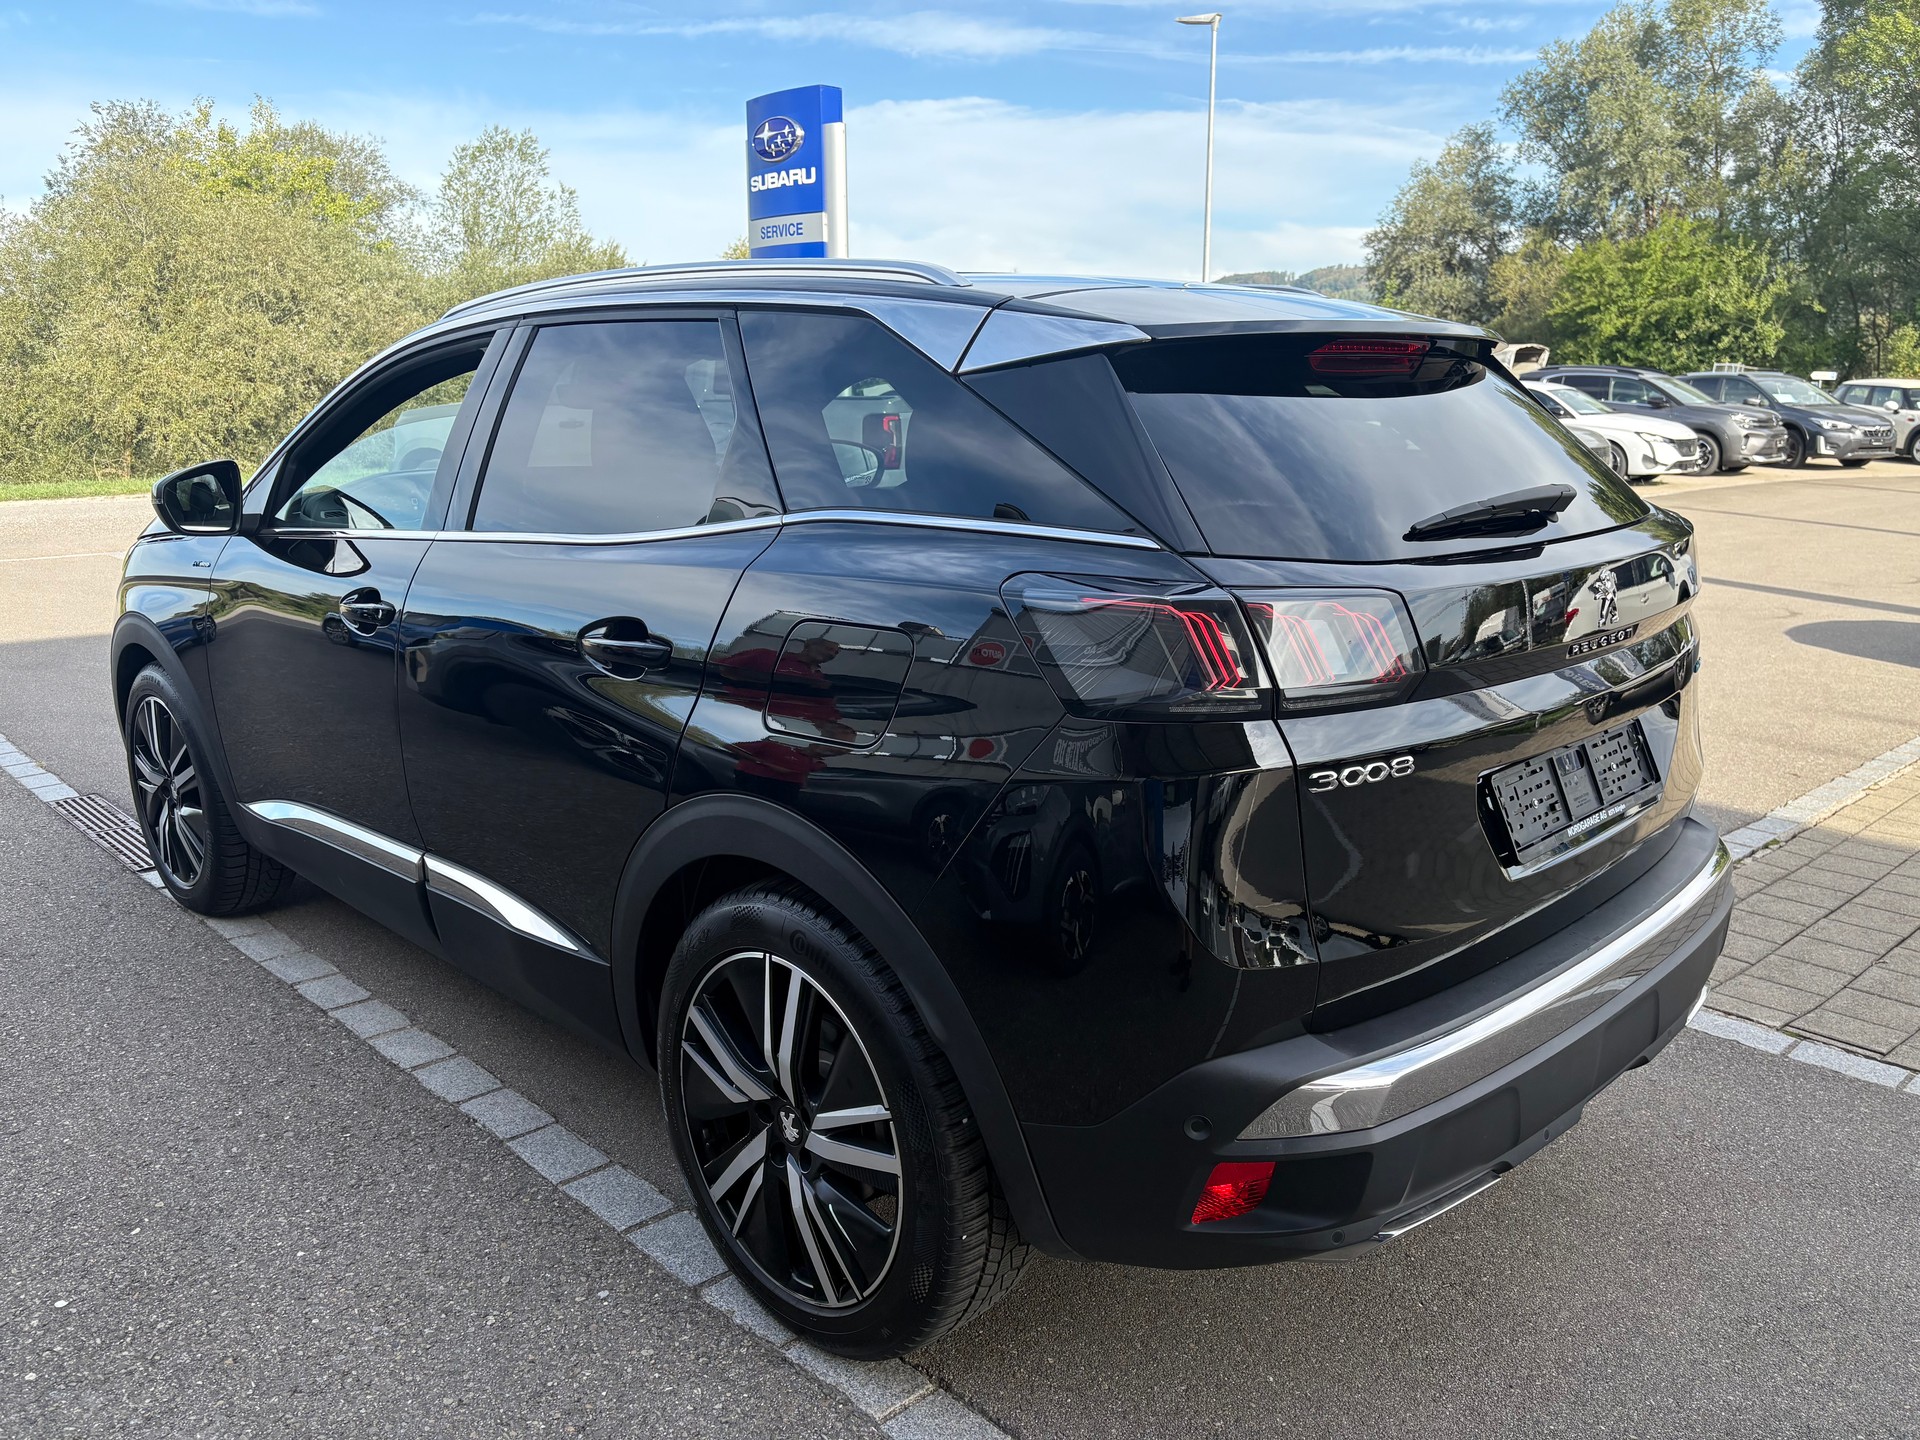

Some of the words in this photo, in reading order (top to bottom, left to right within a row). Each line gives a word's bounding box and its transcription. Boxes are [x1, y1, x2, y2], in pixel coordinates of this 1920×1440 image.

[750, 166, 816, 192] SUBARU
[760, 222, 803, 240] SERVICE
[1572, 627, 1633, 656] PEUGEOT
[1308, 755, 1415, 794] 3008
[1567, 813, 1601, 838] NORDGARAGE
[1600, 810, 1608, 820] AG
